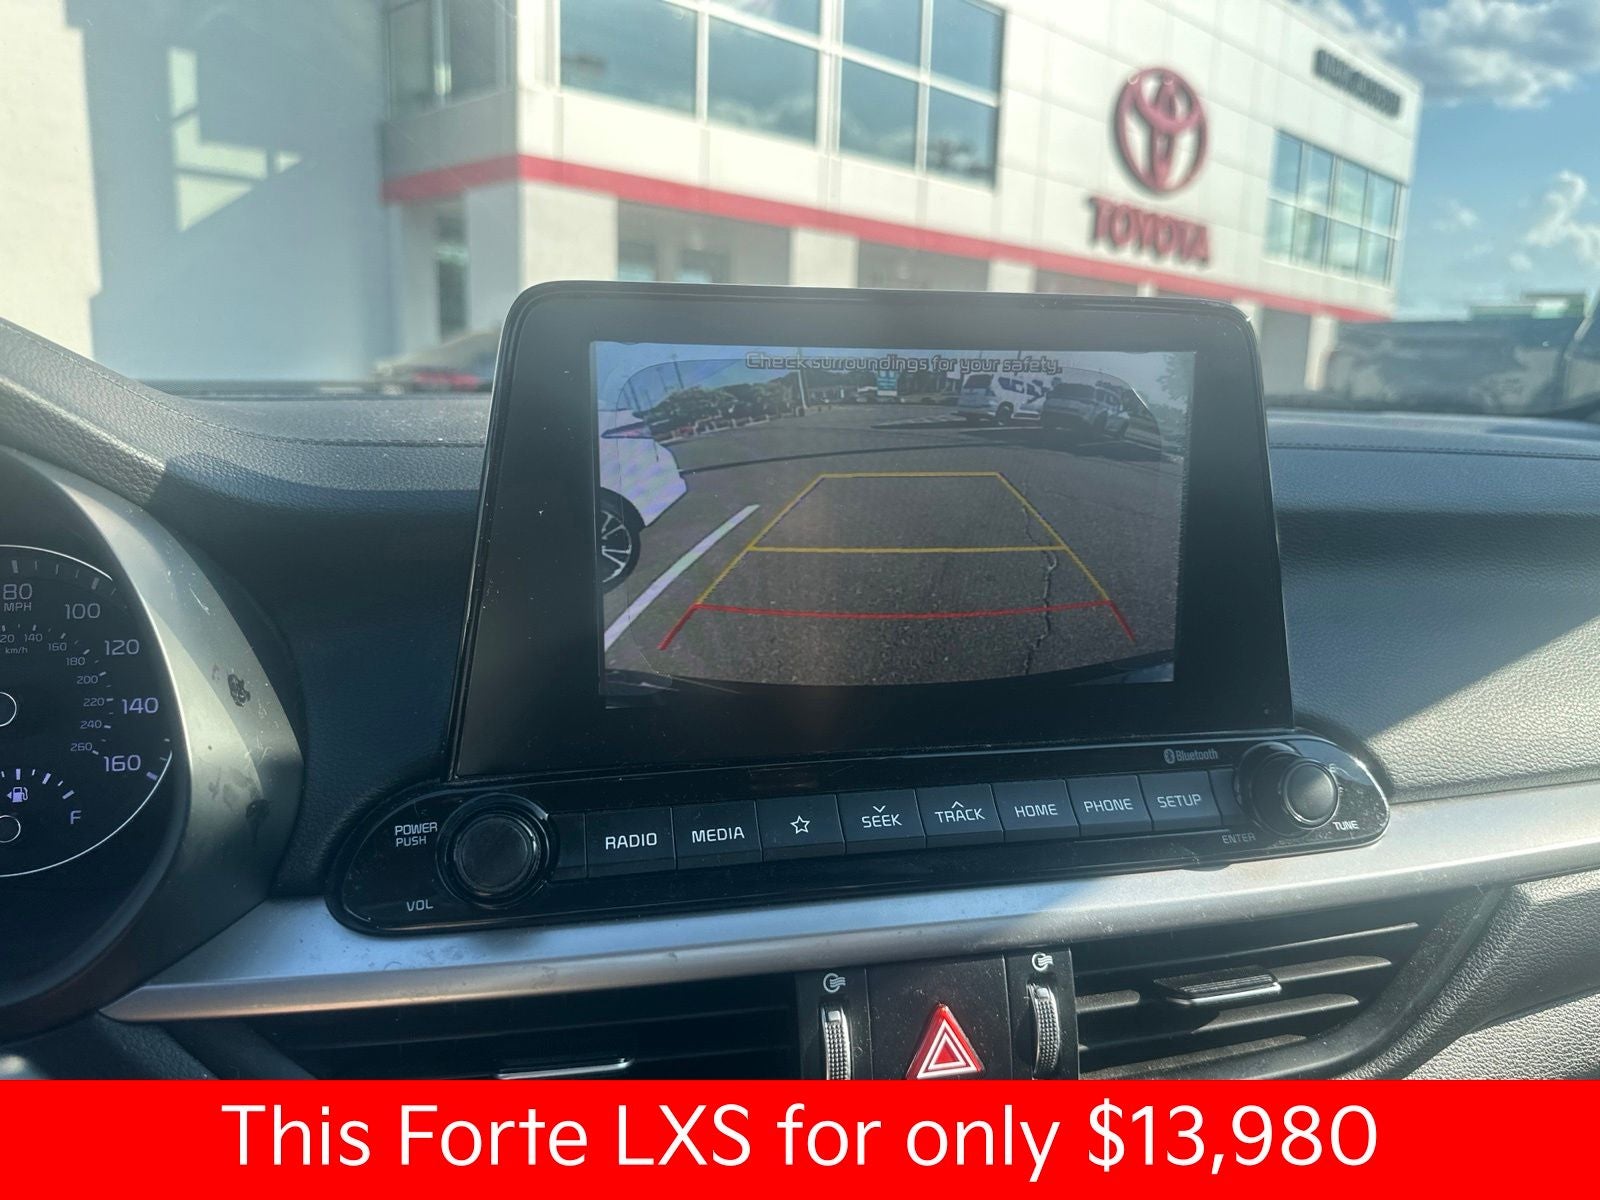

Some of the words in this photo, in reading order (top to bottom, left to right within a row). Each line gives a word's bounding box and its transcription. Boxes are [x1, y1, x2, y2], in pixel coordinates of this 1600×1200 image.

[1086, 196, 1210, 266] TOYOTA
[745, 351, 807, 369] Check
[811, 353, 928, 373] surroundings
[931, 354, 957, 372] for
[960, 357, 1000, 374] your
[1002, 355, 1063, 375] safety.
[3, 583, 33, 600] 80
[4, 602, 32, 612] MPH
[65, 603, 101, 620] 100
[24, 633, 43, 642] 140
[5, 646, 28, 654] km/h
[48, 642, 67, 652] 160
[104, 639, 139, 656] 120
[66, 656, 86, 666] 180
[76, 675, 99, 685] 200
[83, 697, 105, 707] 220
[121, 697, 159, 714] 140
[80, 719, 102, 730] 240
[70, 742, 93, 752] 260
[1176, 748, 1219, 762] Bluetooth
[103, 754, 142, 772] 160
[1083, 797, 1133, 813] PHONE
[1157, 792, 1201, 809] SETUP
[70, 810, 82, 825] F
[934, 807, 985, 824] TRACK
[1014, 803, 1059, 818] HOME
[394, 820, 438, 836] POWER
[861, 813, 902, 829] SEEK
[1332, 818, 1360, 832] TUNE
[395, 834, 428, 848] PUSH
[604, 831, 658, 850] RADIO
[691, 826, 745, 844] MEDIA
[1221, 831, 1256, 845] ENTER
[406, 898, 434, 912] VOL
